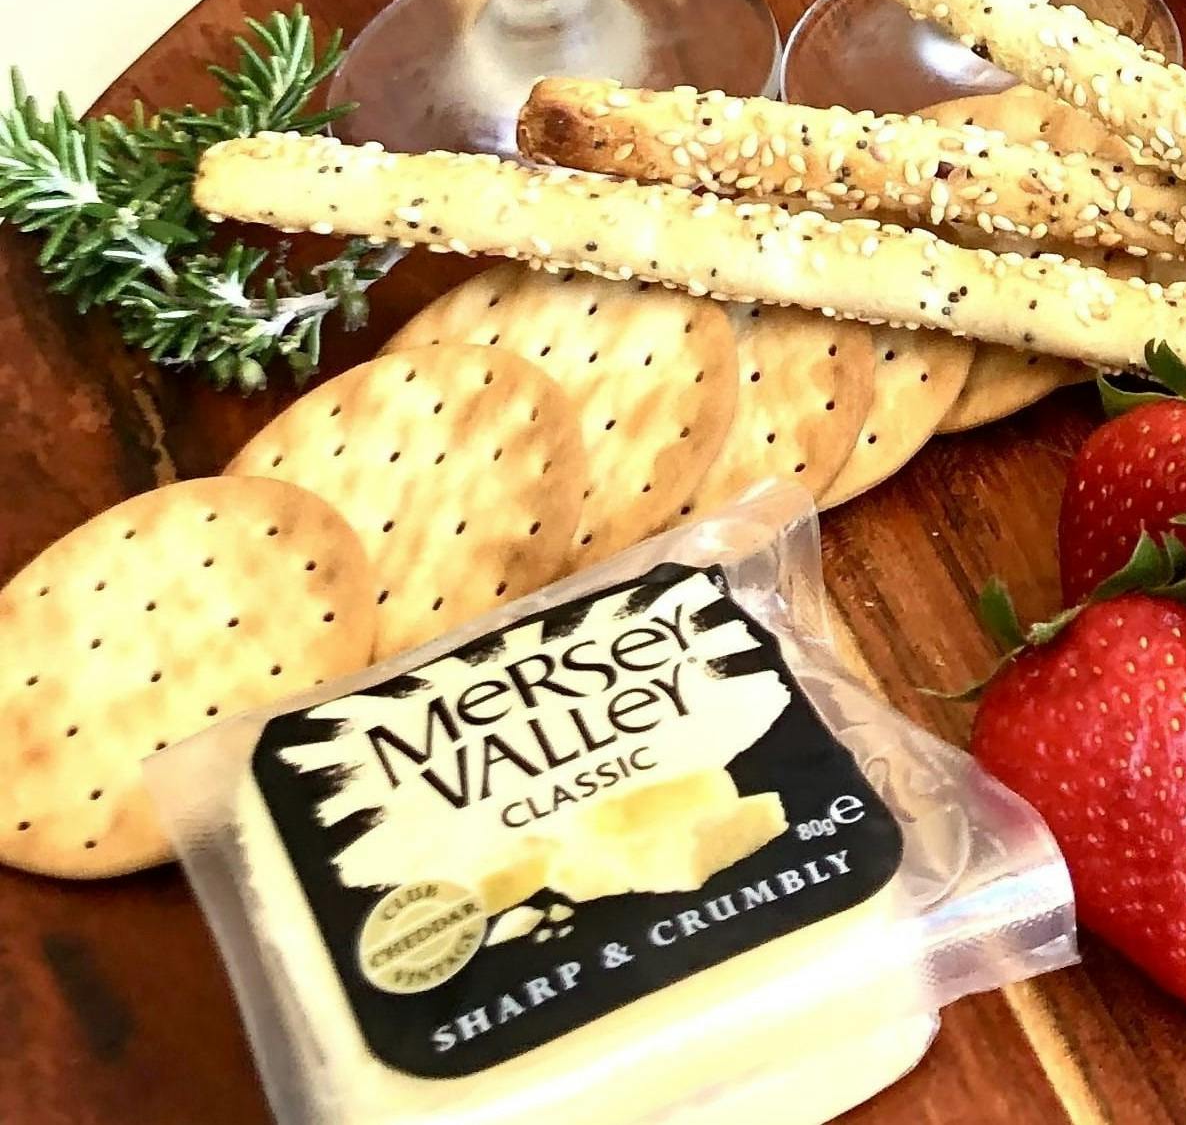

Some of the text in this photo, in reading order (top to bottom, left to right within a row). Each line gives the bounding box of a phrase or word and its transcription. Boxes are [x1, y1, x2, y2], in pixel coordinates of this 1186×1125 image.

[501, 747, 657, 828] CLASSIC
[430, 849, 852, 1053] SHARP & CRUMBLY
